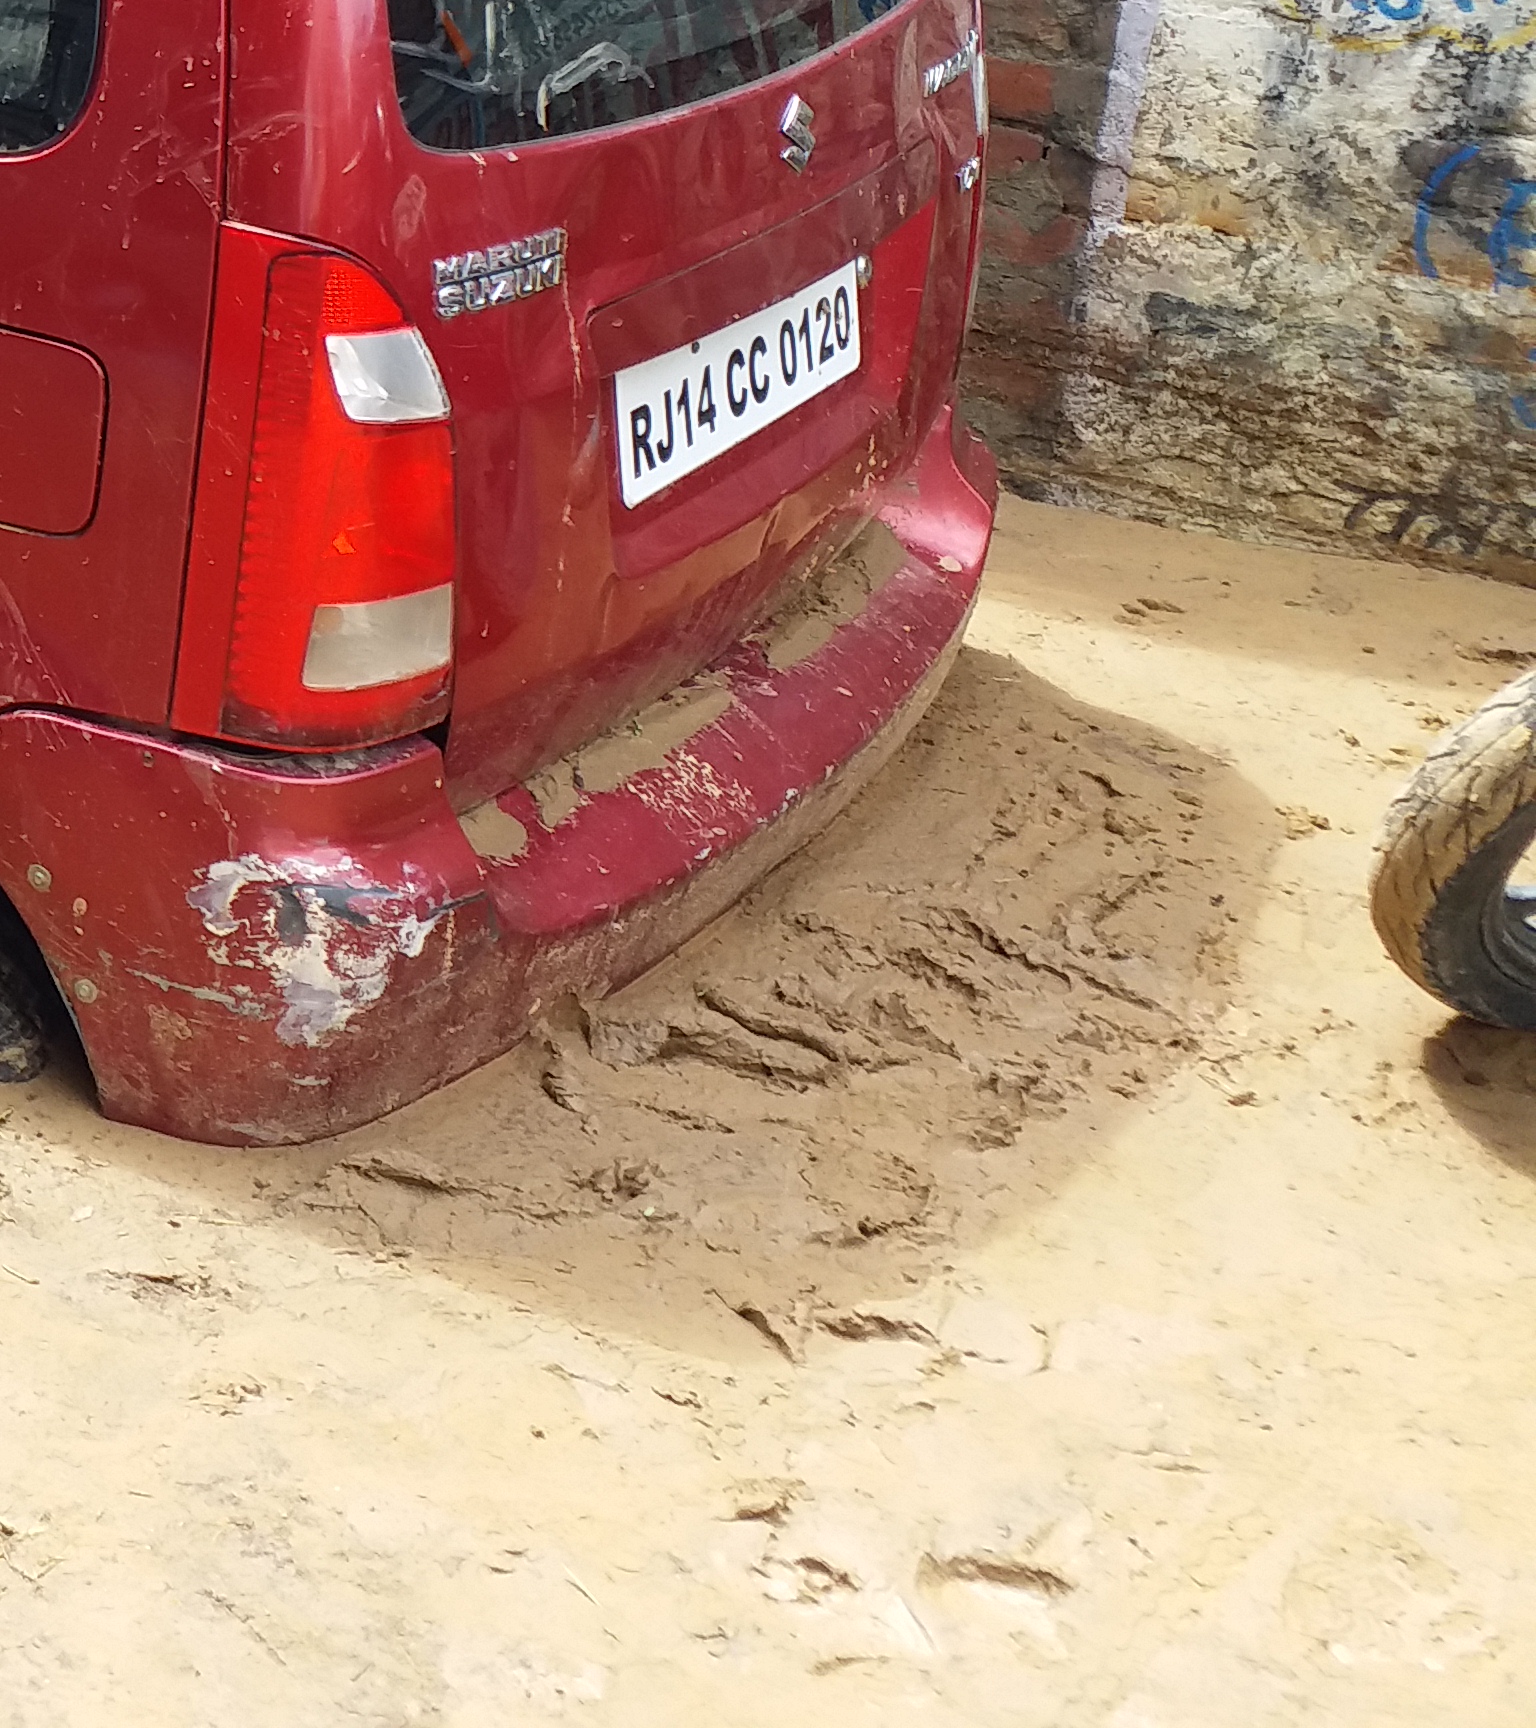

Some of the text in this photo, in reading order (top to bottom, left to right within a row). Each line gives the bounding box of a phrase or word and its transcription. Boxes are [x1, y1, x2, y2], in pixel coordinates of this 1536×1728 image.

[432, 227, 567, 285] MARUTI
[436, 254, 565, 320] SUZUKI
[630, 285, 851, 479] RJ14 CC 0120
